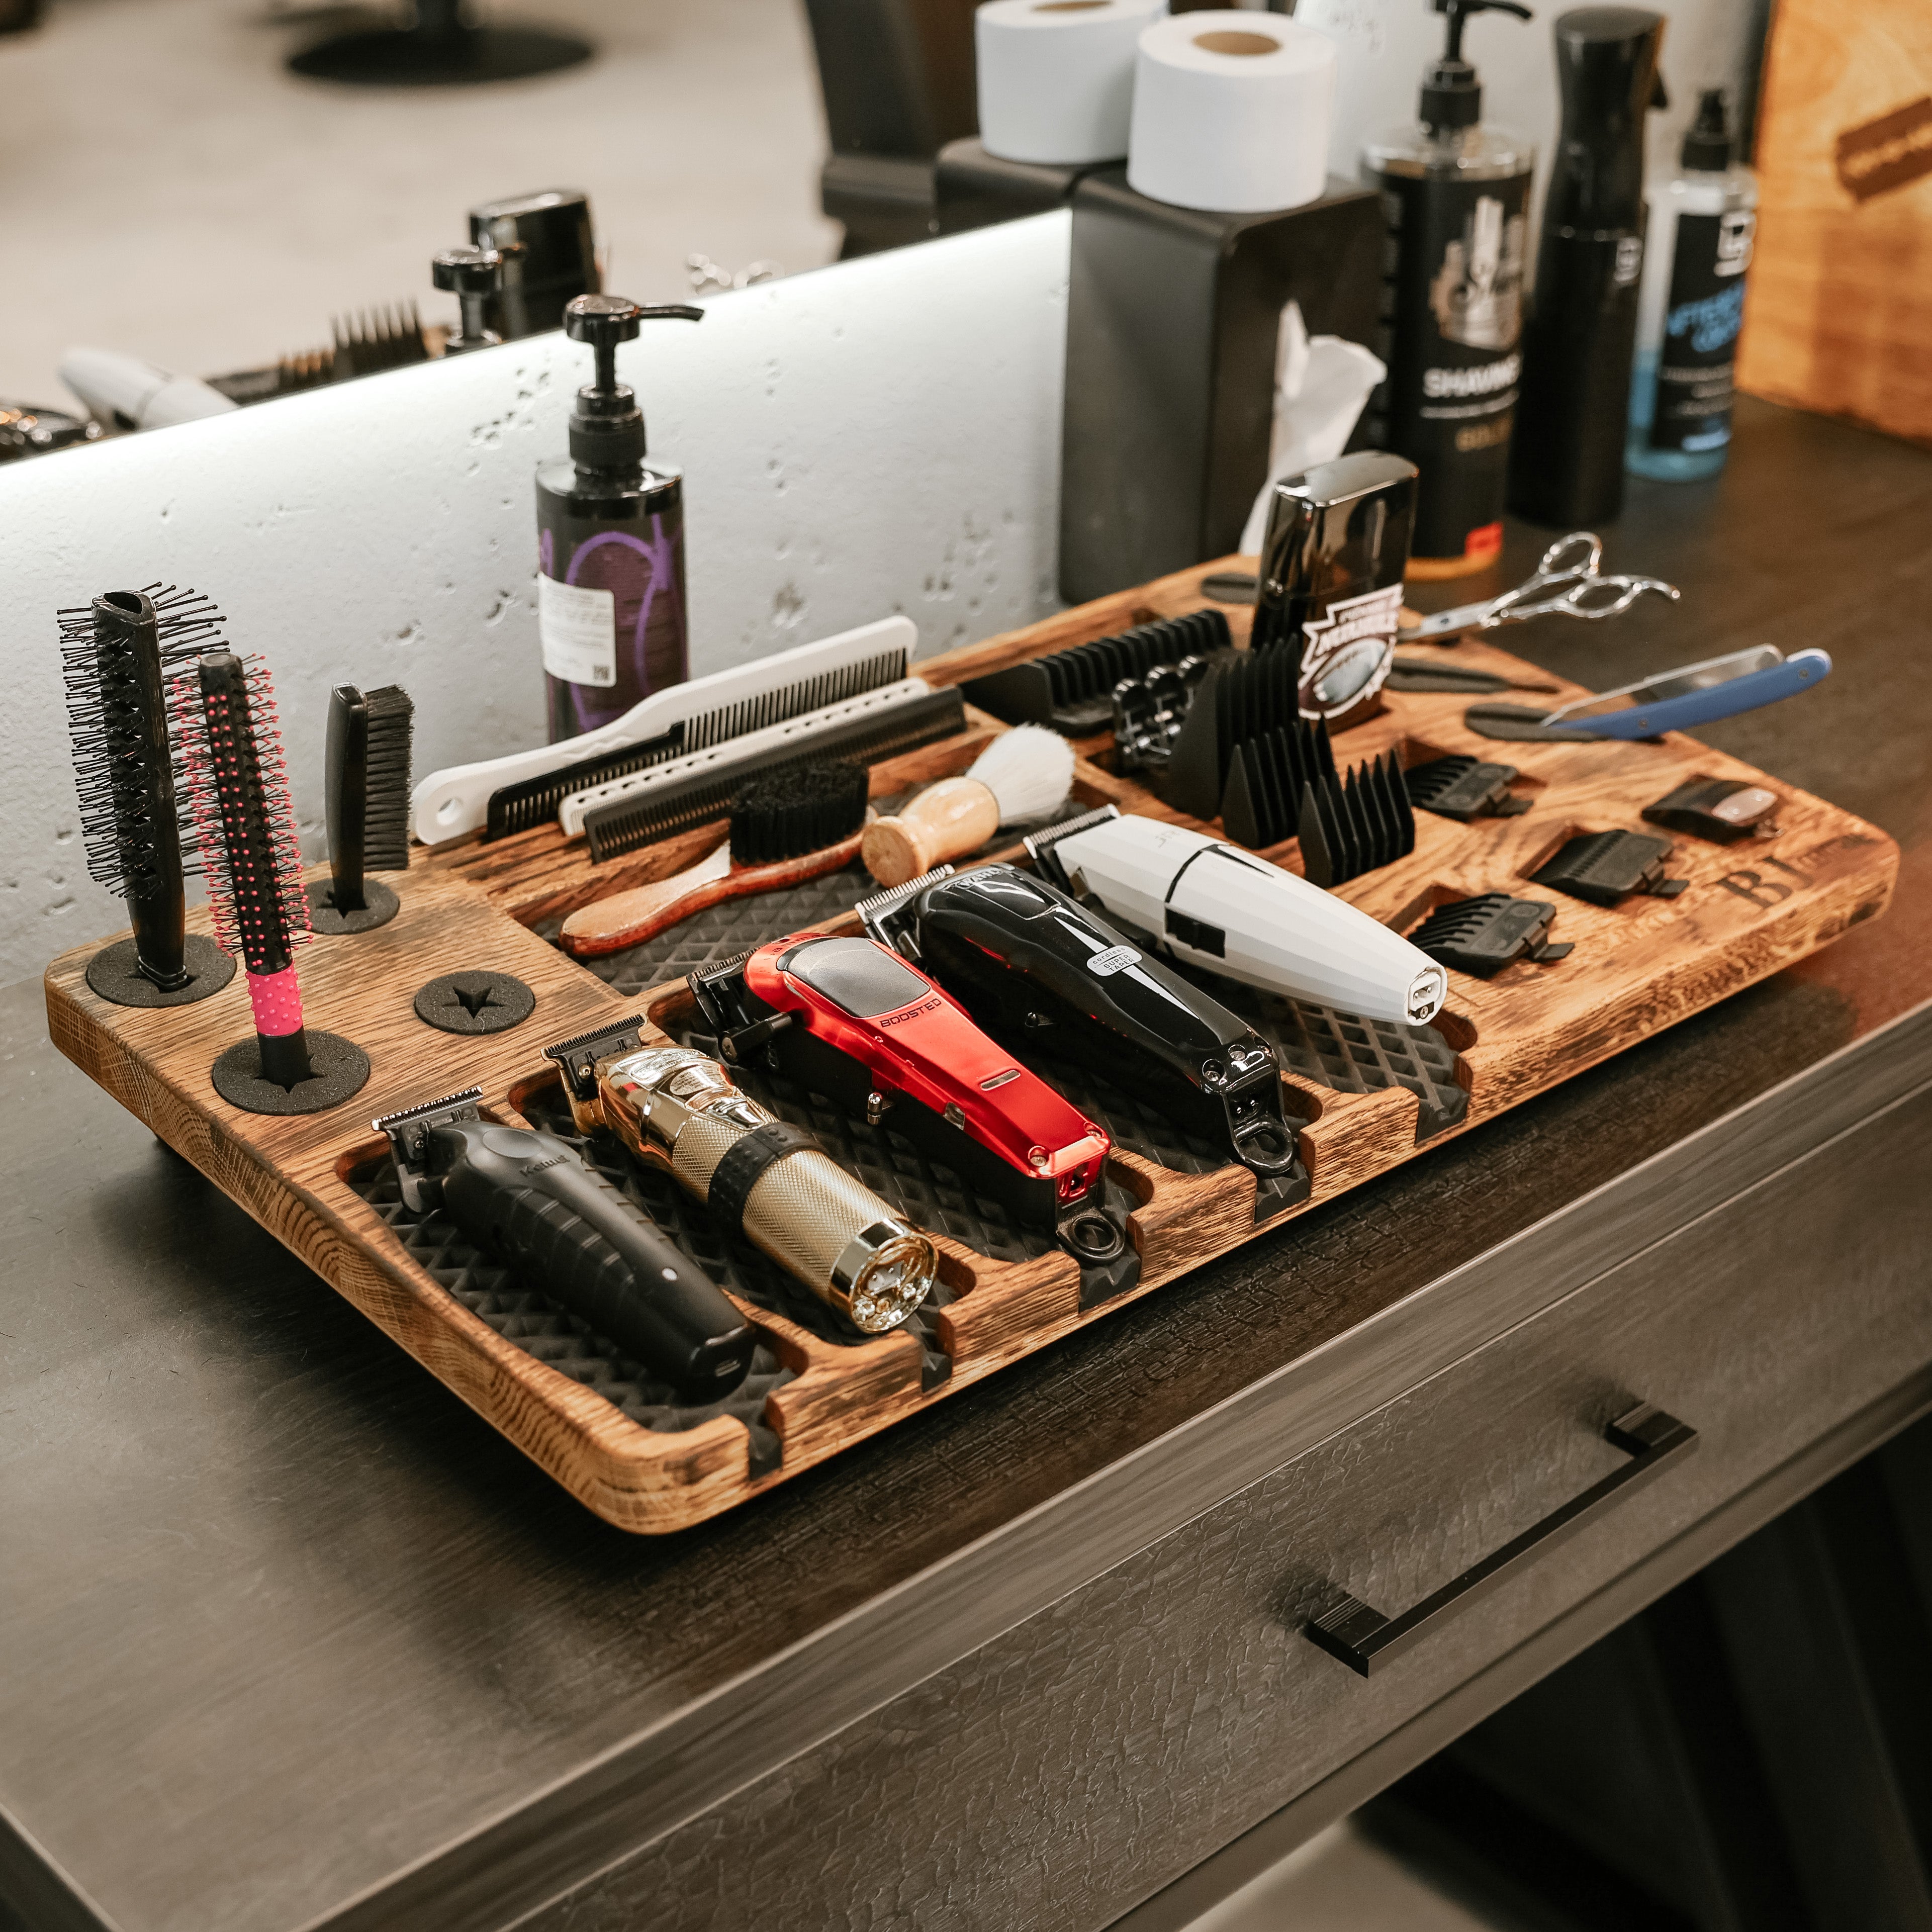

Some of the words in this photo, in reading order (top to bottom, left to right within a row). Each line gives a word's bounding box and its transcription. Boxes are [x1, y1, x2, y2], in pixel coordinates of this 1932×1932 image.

[958, 870, 1001, 887] WAHL
[1093, 948, 1126, 964] cordless
[1103, 954, 1131, 969] SUPER
[1109, 959, 1135, 971] TAPER
[879, 998, 942, 1028] BOOSTED
